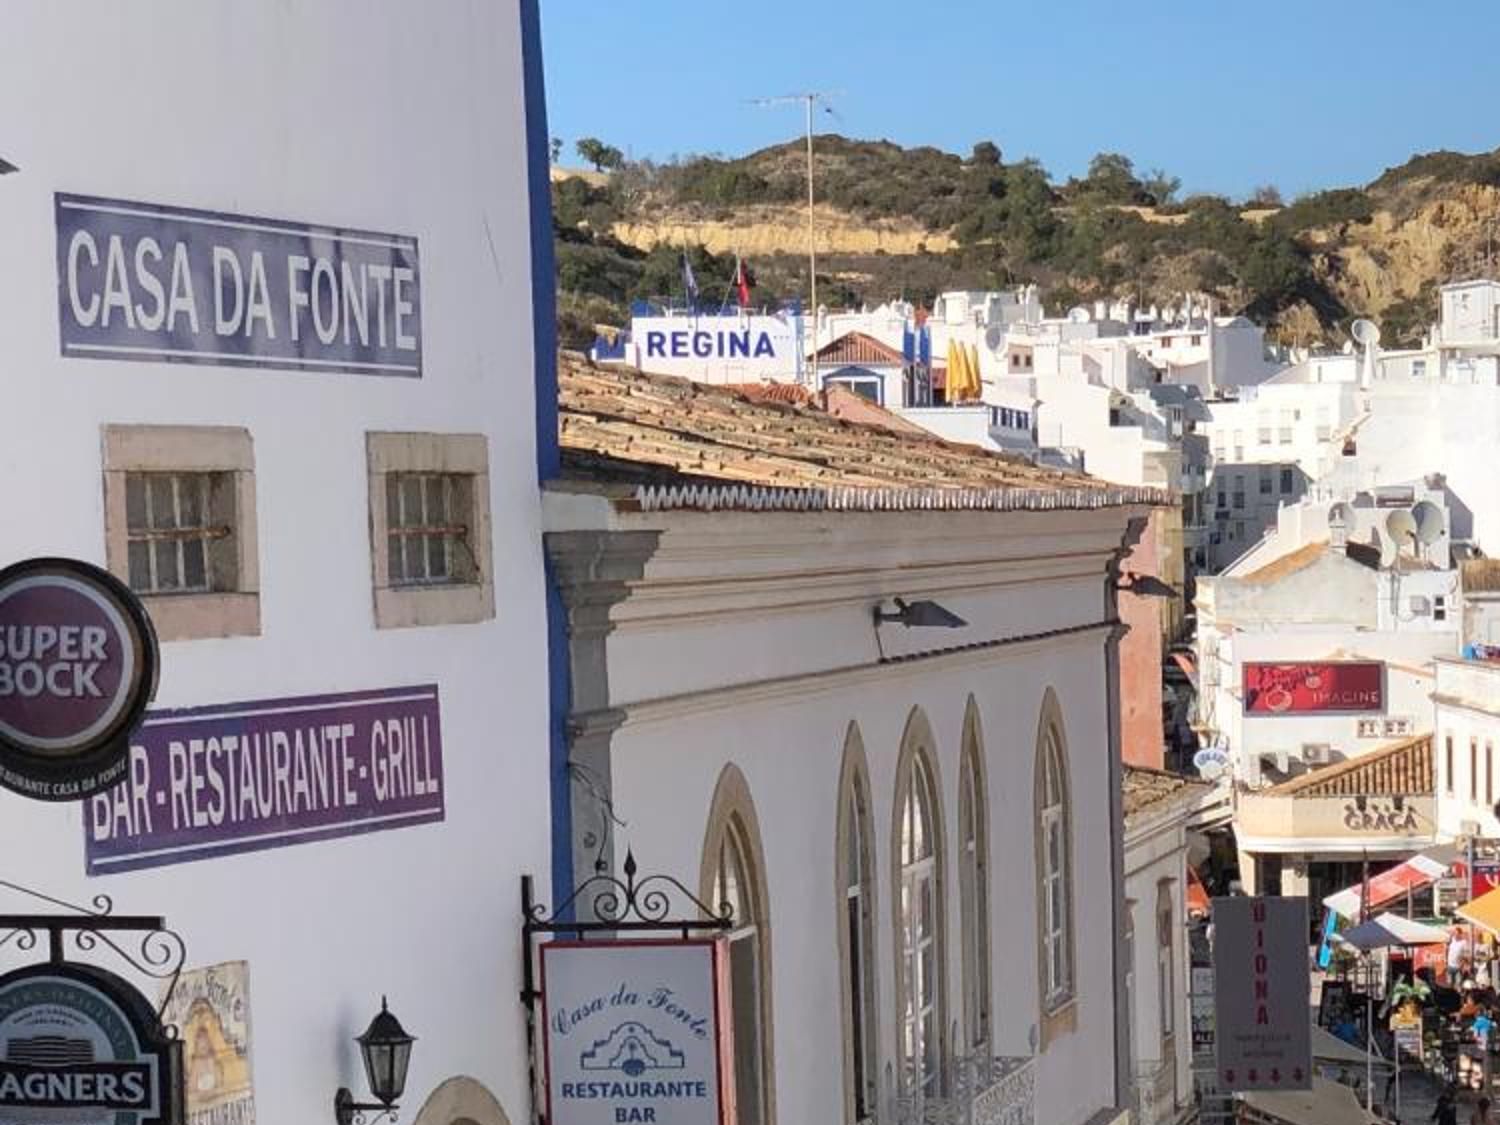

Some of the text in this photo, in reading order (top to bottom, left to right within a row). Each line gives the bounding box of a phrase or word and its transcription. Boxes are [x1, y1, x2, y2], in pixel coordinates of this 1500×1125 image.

[67, 229, 417, 350] CASA DA FONTE
[646, 331, 776, 358] REGINA
[0, 625, 108, 660] UPER
[1312, 690, 1379, 704] IMAGINE
[552, 982, 708, 1038] Casa da Fonte
[563, 1082, 707, 1098] RESTAURANTE
[615, 1107, 656, 1122] BAR
